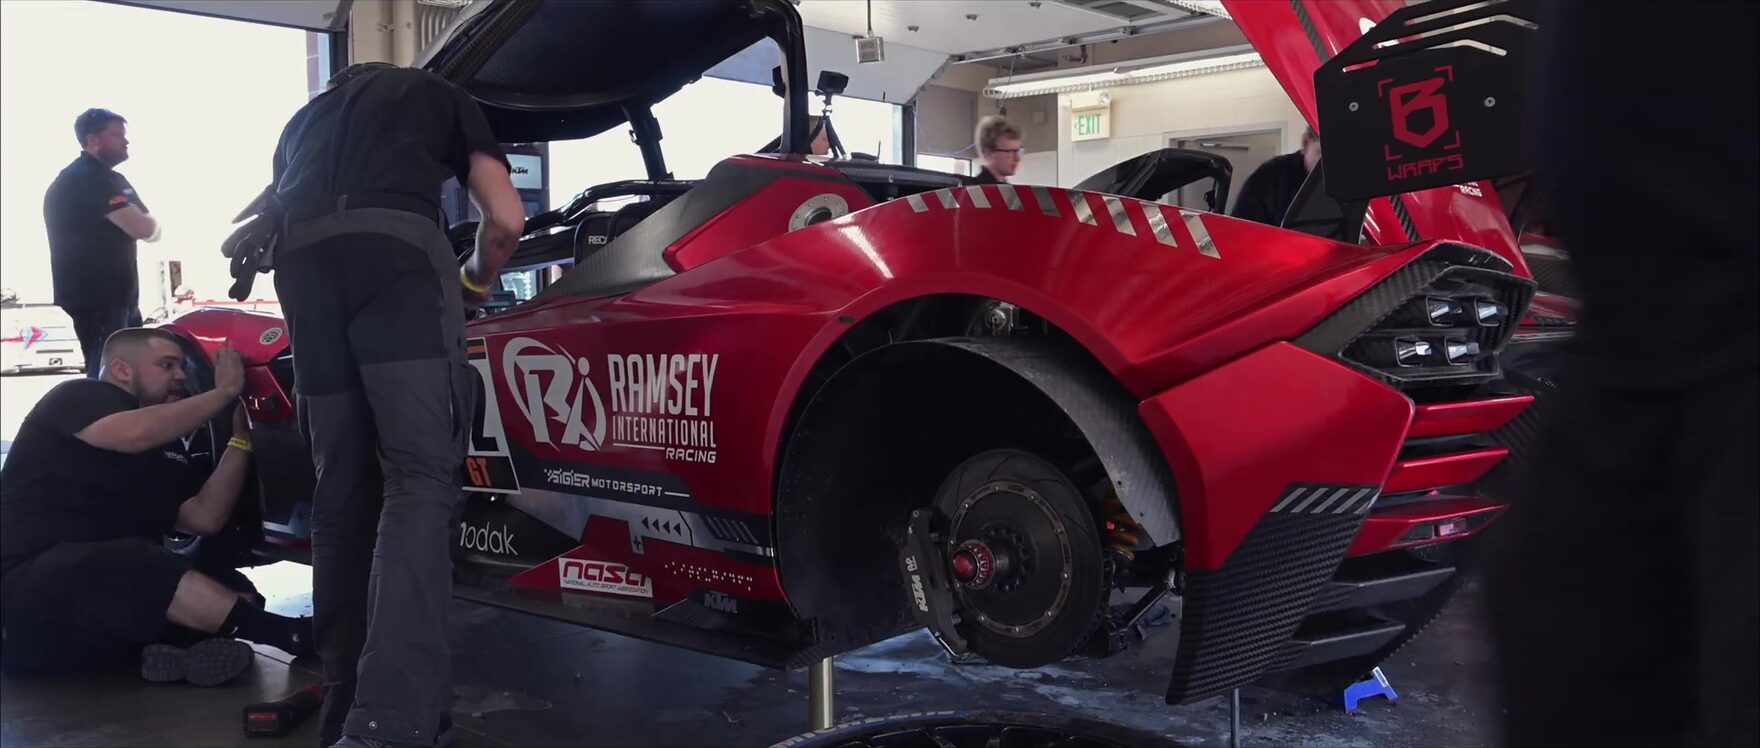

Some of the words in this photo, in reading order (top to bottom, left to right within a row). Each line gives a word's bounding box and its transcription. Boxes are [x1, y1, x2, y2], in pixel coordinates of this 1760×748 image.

[1078, 112, 1102, 136] EXIT
[1387, 153, 1464, 181] WRAPS
[607, 353, 719, 417] RAMSEY
[612, 415, 717, 448] INTERNATIONAL
[665, 447, 717, 464] RACING
[465, 457, 492, 487] GT
[591, 478, 663, 497] MOTORSPORT
[704, 589, 738, 614] KTM
